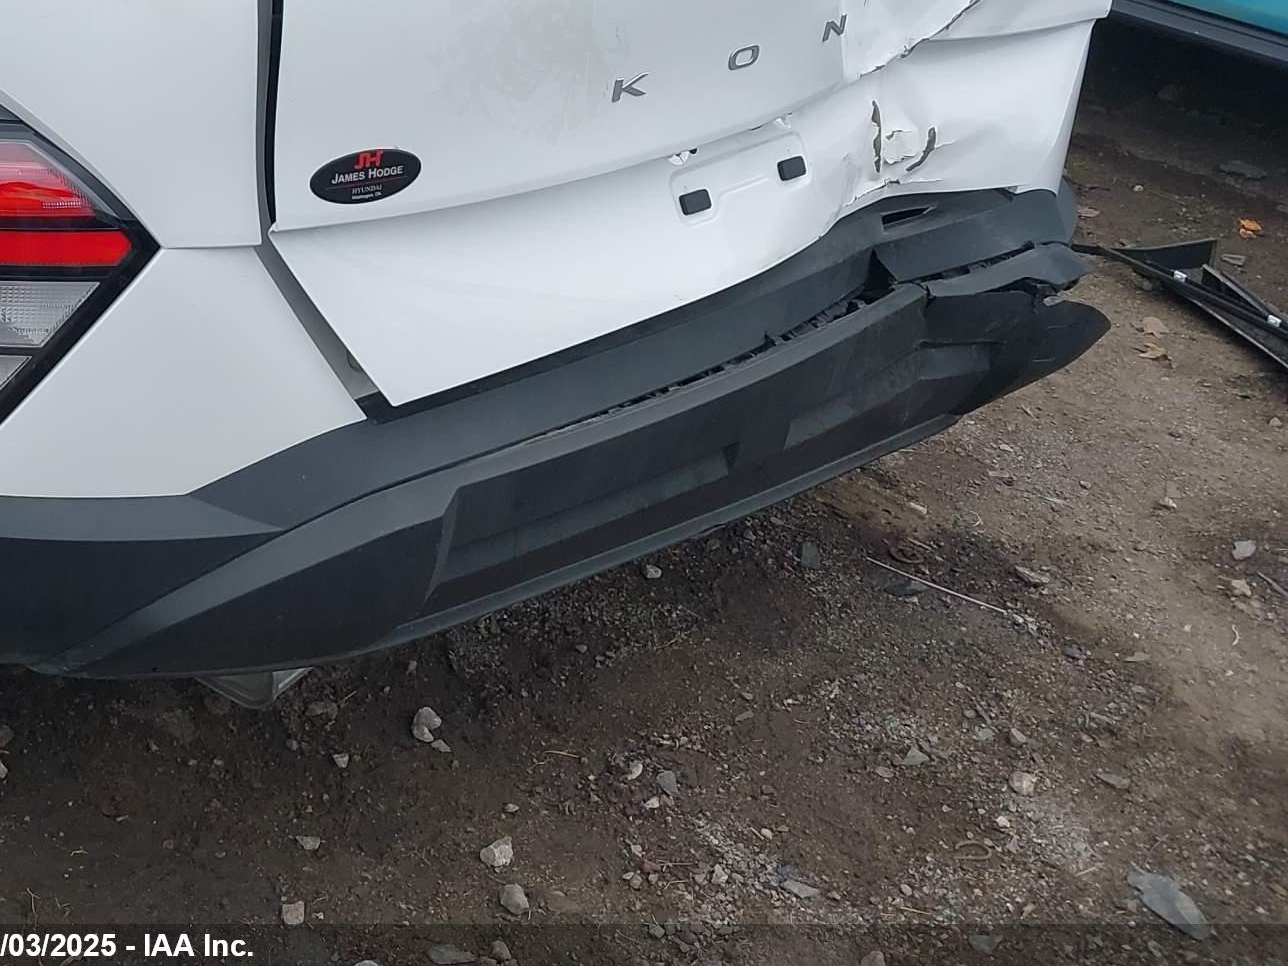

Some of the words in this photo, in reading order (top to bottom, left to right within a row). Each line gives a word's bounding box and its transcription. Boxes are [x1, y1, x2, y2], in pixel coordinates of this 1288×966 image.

[331, 171, 366, 185] JAMES
[368, 165, 405, 180] HODGE
[351, 184, 383, 194] HYUNDAI
